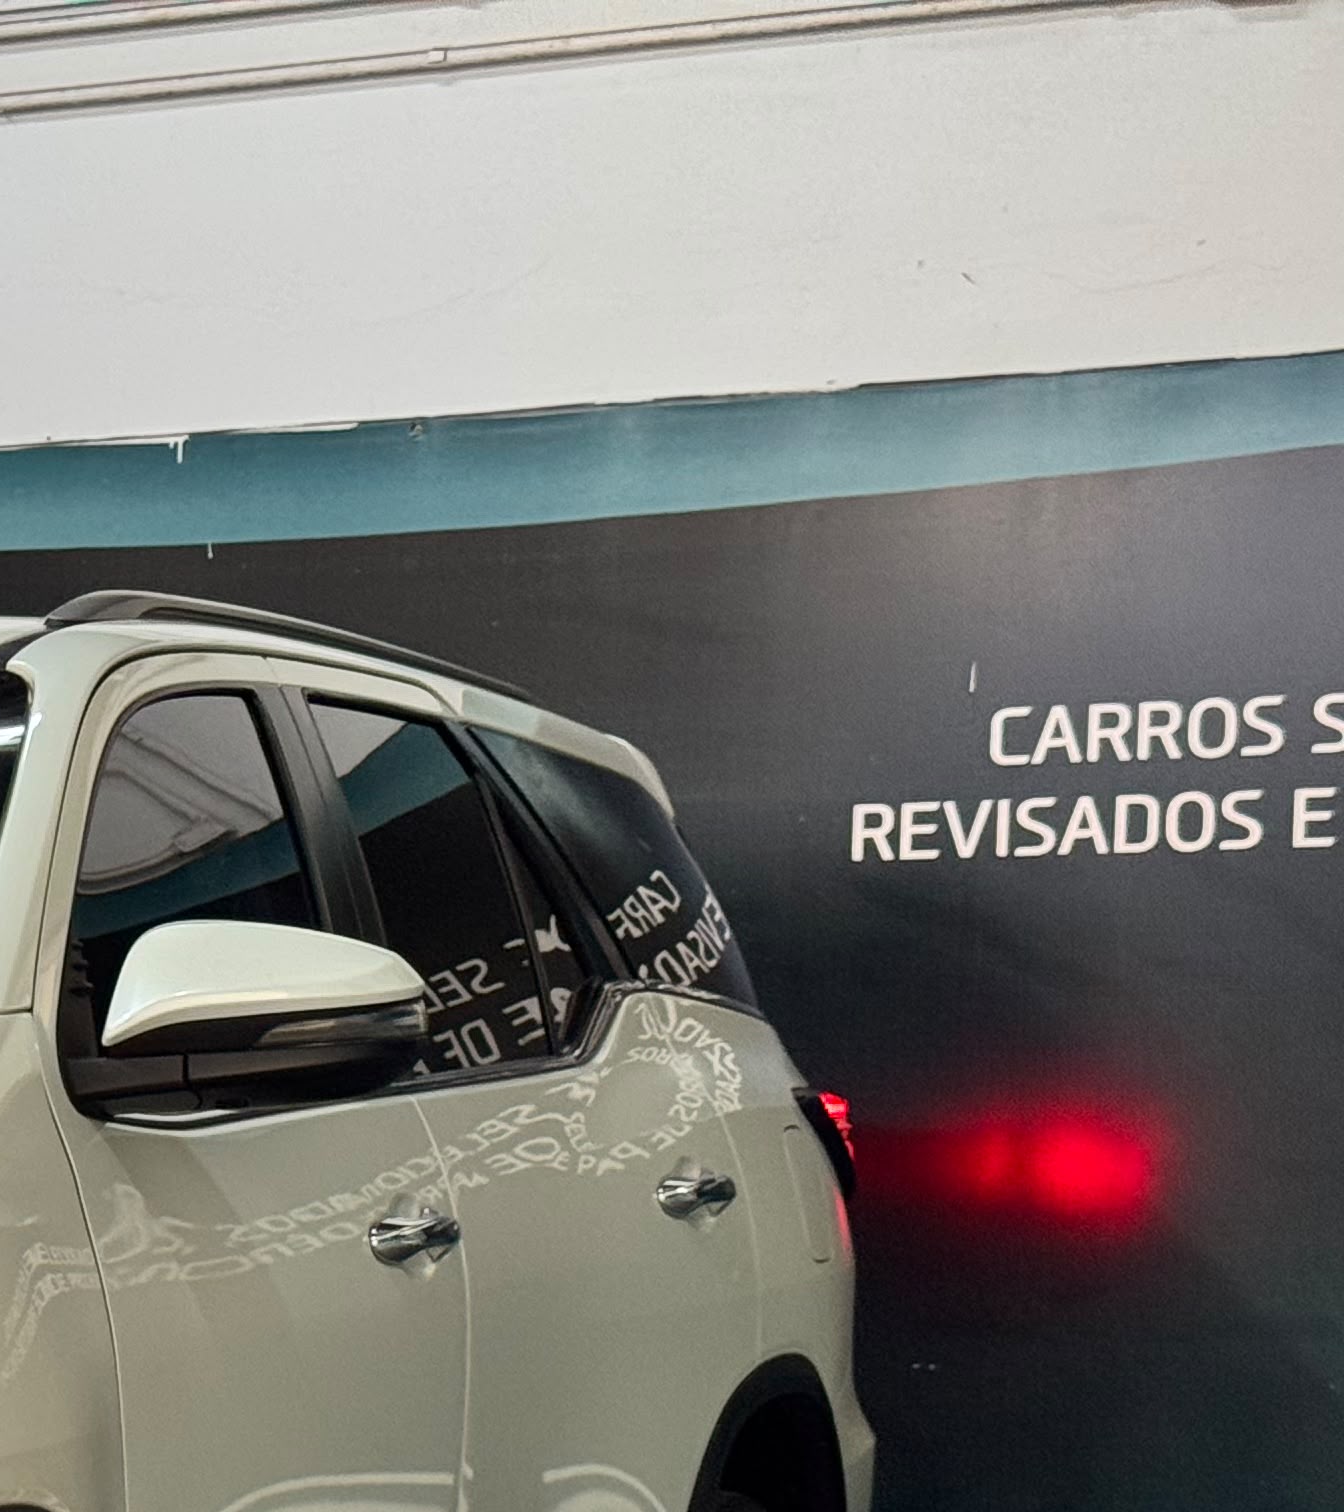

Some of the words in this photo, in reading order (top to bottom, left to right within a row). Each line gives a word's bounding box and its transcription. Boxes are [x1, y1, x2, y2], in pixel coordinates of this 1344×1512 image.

[989, 695, 1287, 767] CARROS
[850, 788, 1265, 863] REVISADOS
[1292, 786, 1339, 850] E
